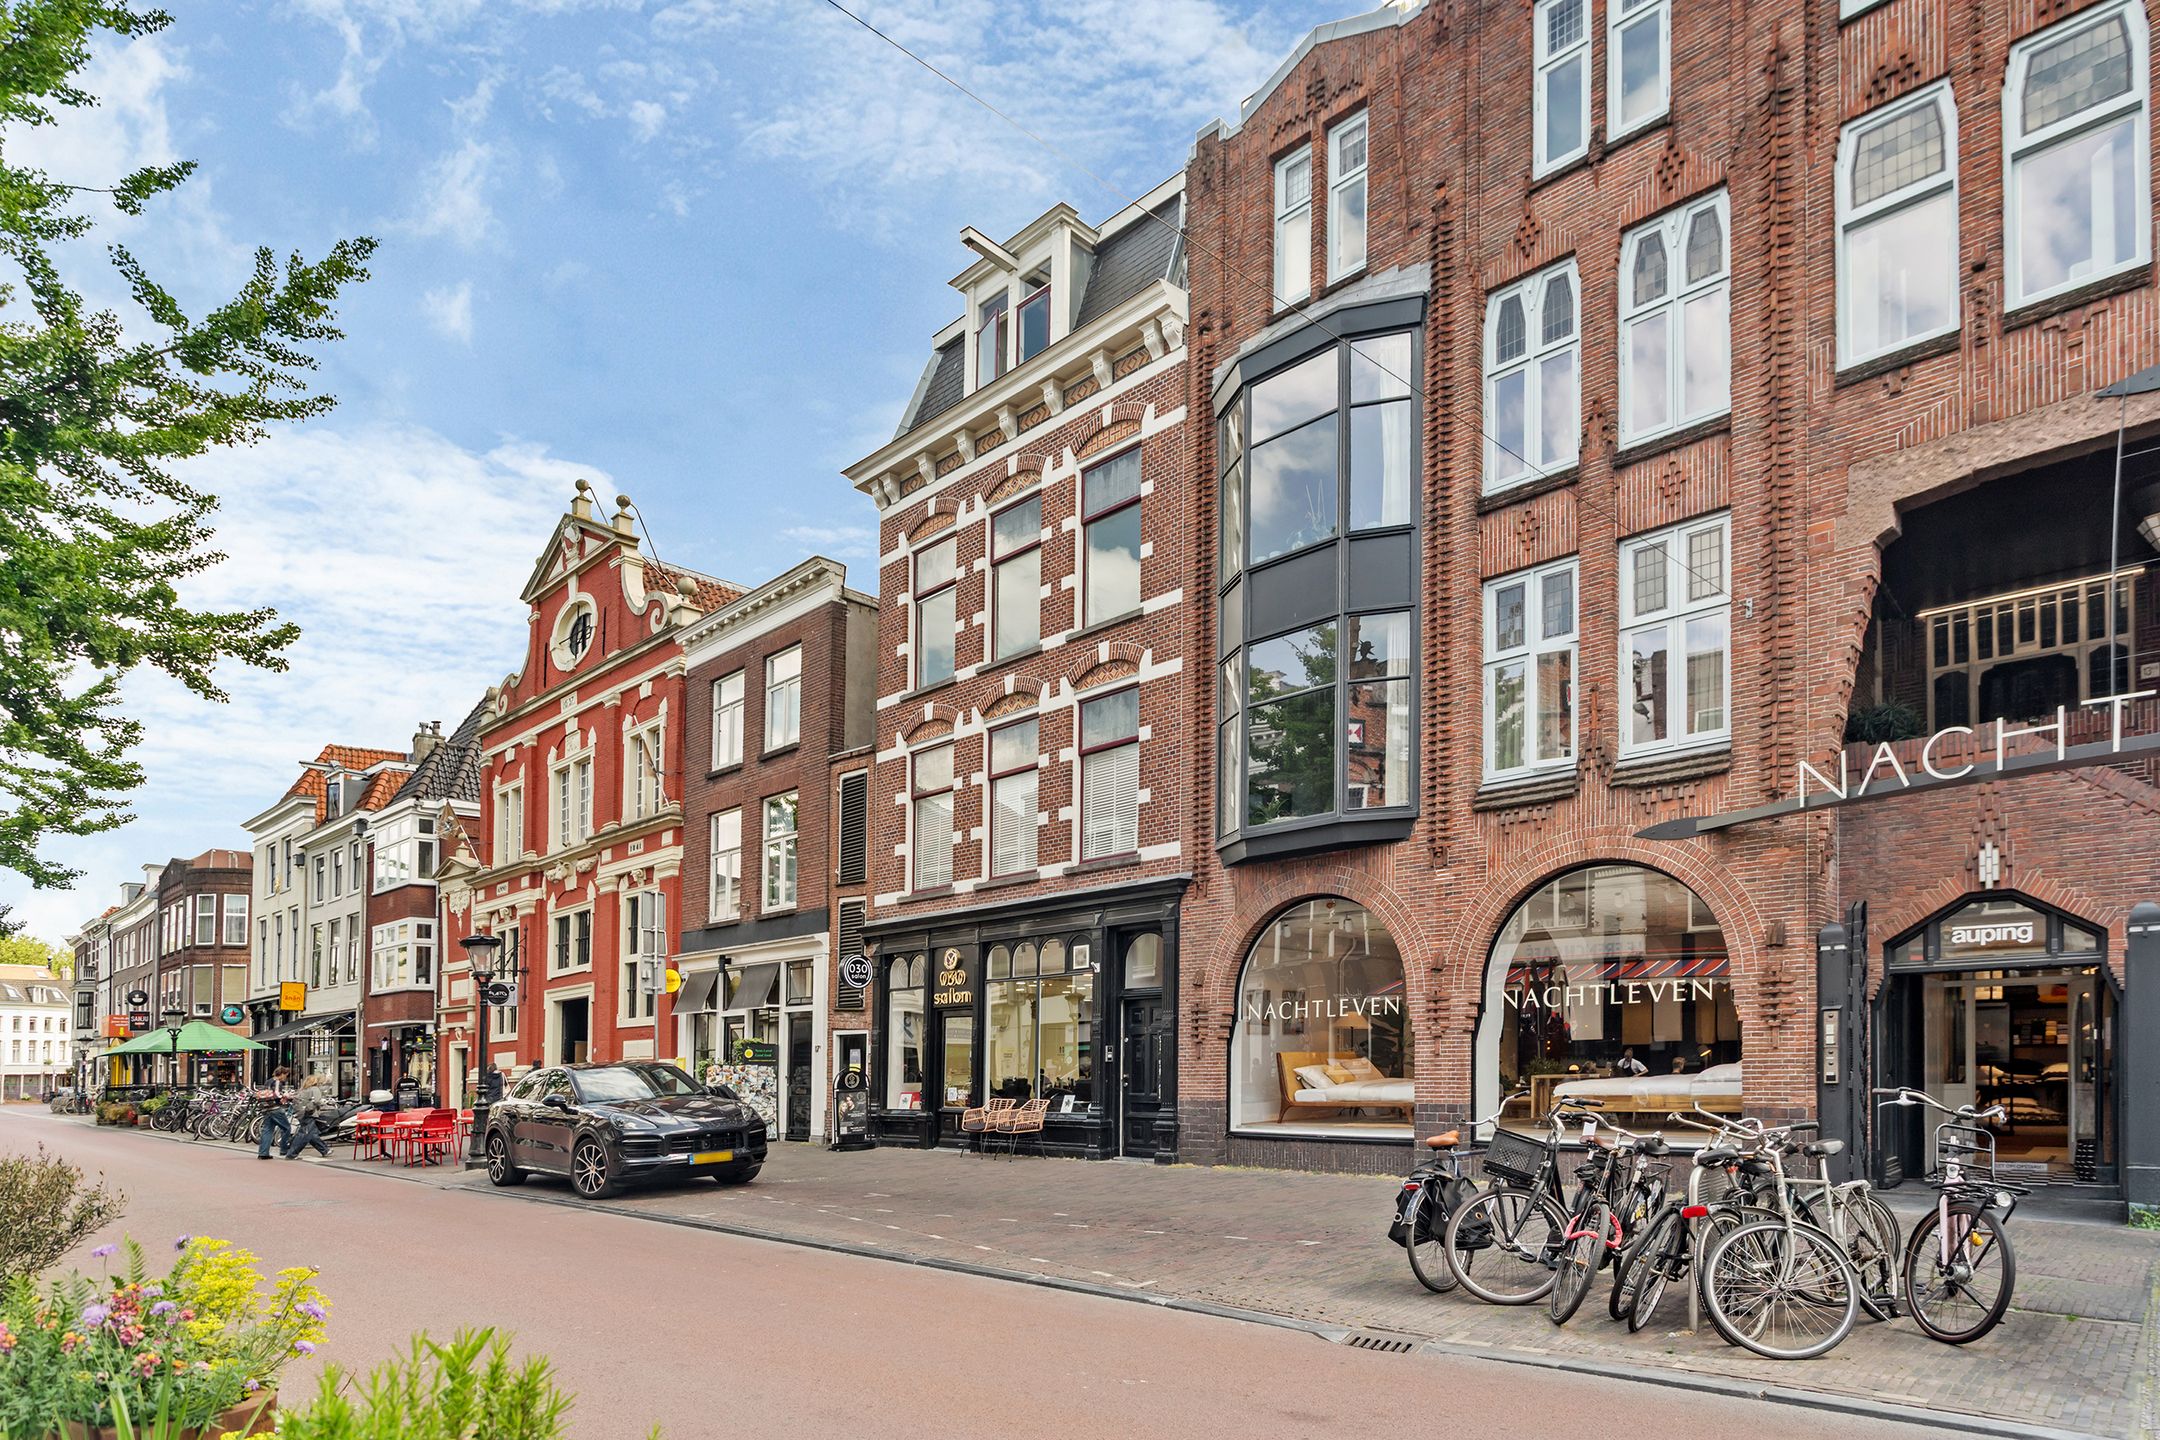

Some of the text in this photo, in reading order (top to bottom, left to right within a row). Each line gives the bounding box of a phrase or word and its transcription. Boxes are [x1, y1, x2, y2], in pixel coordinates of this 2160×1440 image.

[1799, 690, 2157, 808] NACHT
[1951, 923, 2033, 946] auping
[849, 963, 868, 974] 030
[940, 970, 966, 987] 030
[933, 988, 973, 1005] salon
[1501, 978, 1713, 1009] NACHTLEVEN
[1248, 996, 1400, 1020] NACHTLEVEN
